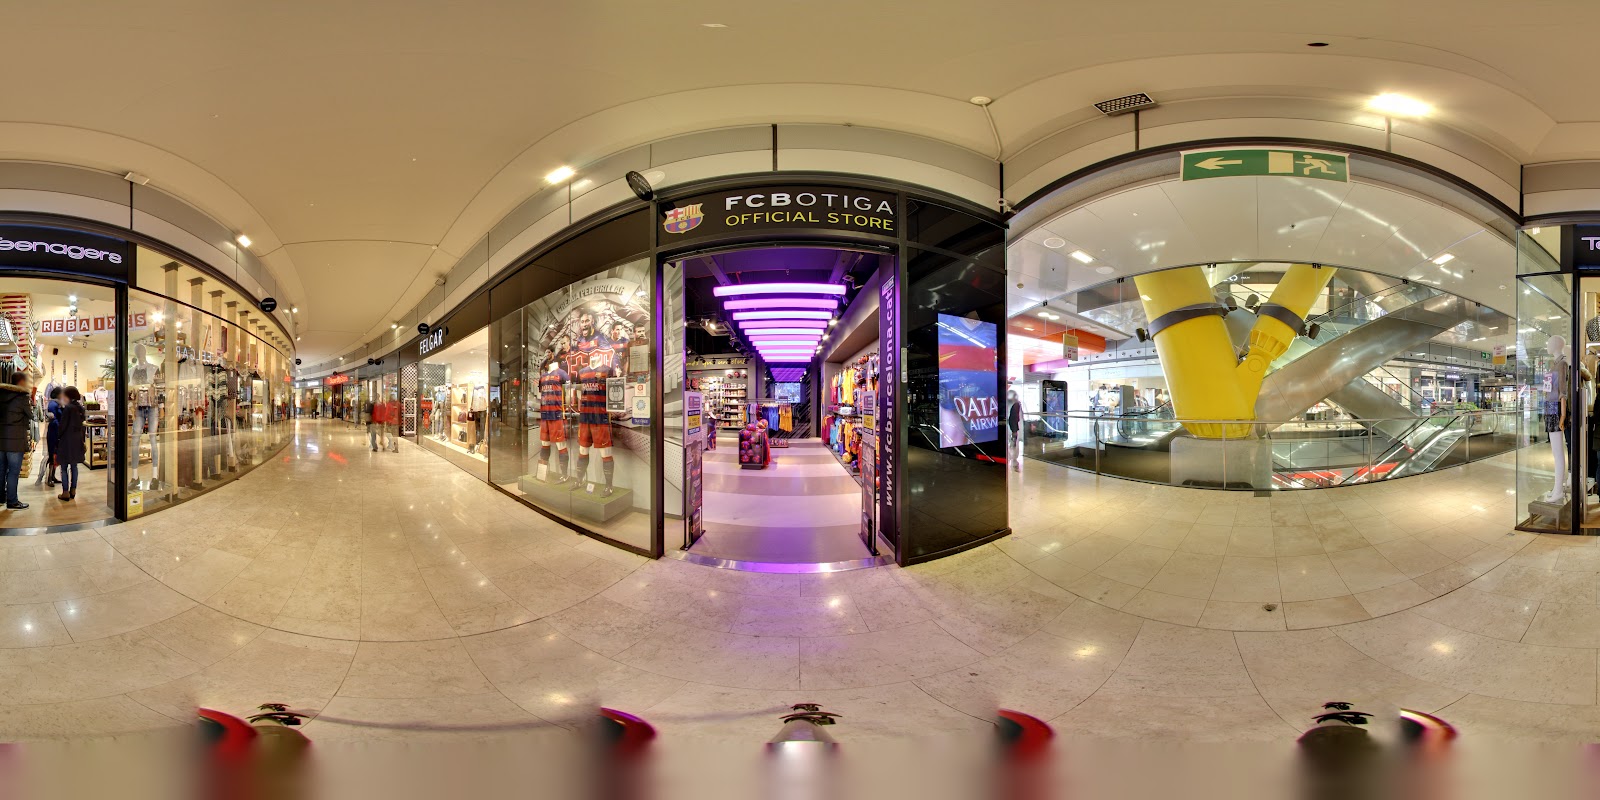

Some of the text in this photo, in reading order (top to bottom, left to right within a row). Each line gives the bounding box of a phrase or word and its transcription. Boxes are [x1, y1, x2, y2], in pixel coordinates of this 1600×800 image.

[725, 192, 894, 215] FCBOTIGA
[725, 211, 894, 231] OFFICIAL STORE
[0, 238, 122, 264] eenagers
[43, 314, 145, 332] REBAIXS
[419, 329, 443, 356] FELGAR
[884, 289, 893, 506] www.fcbarcelona.cat
